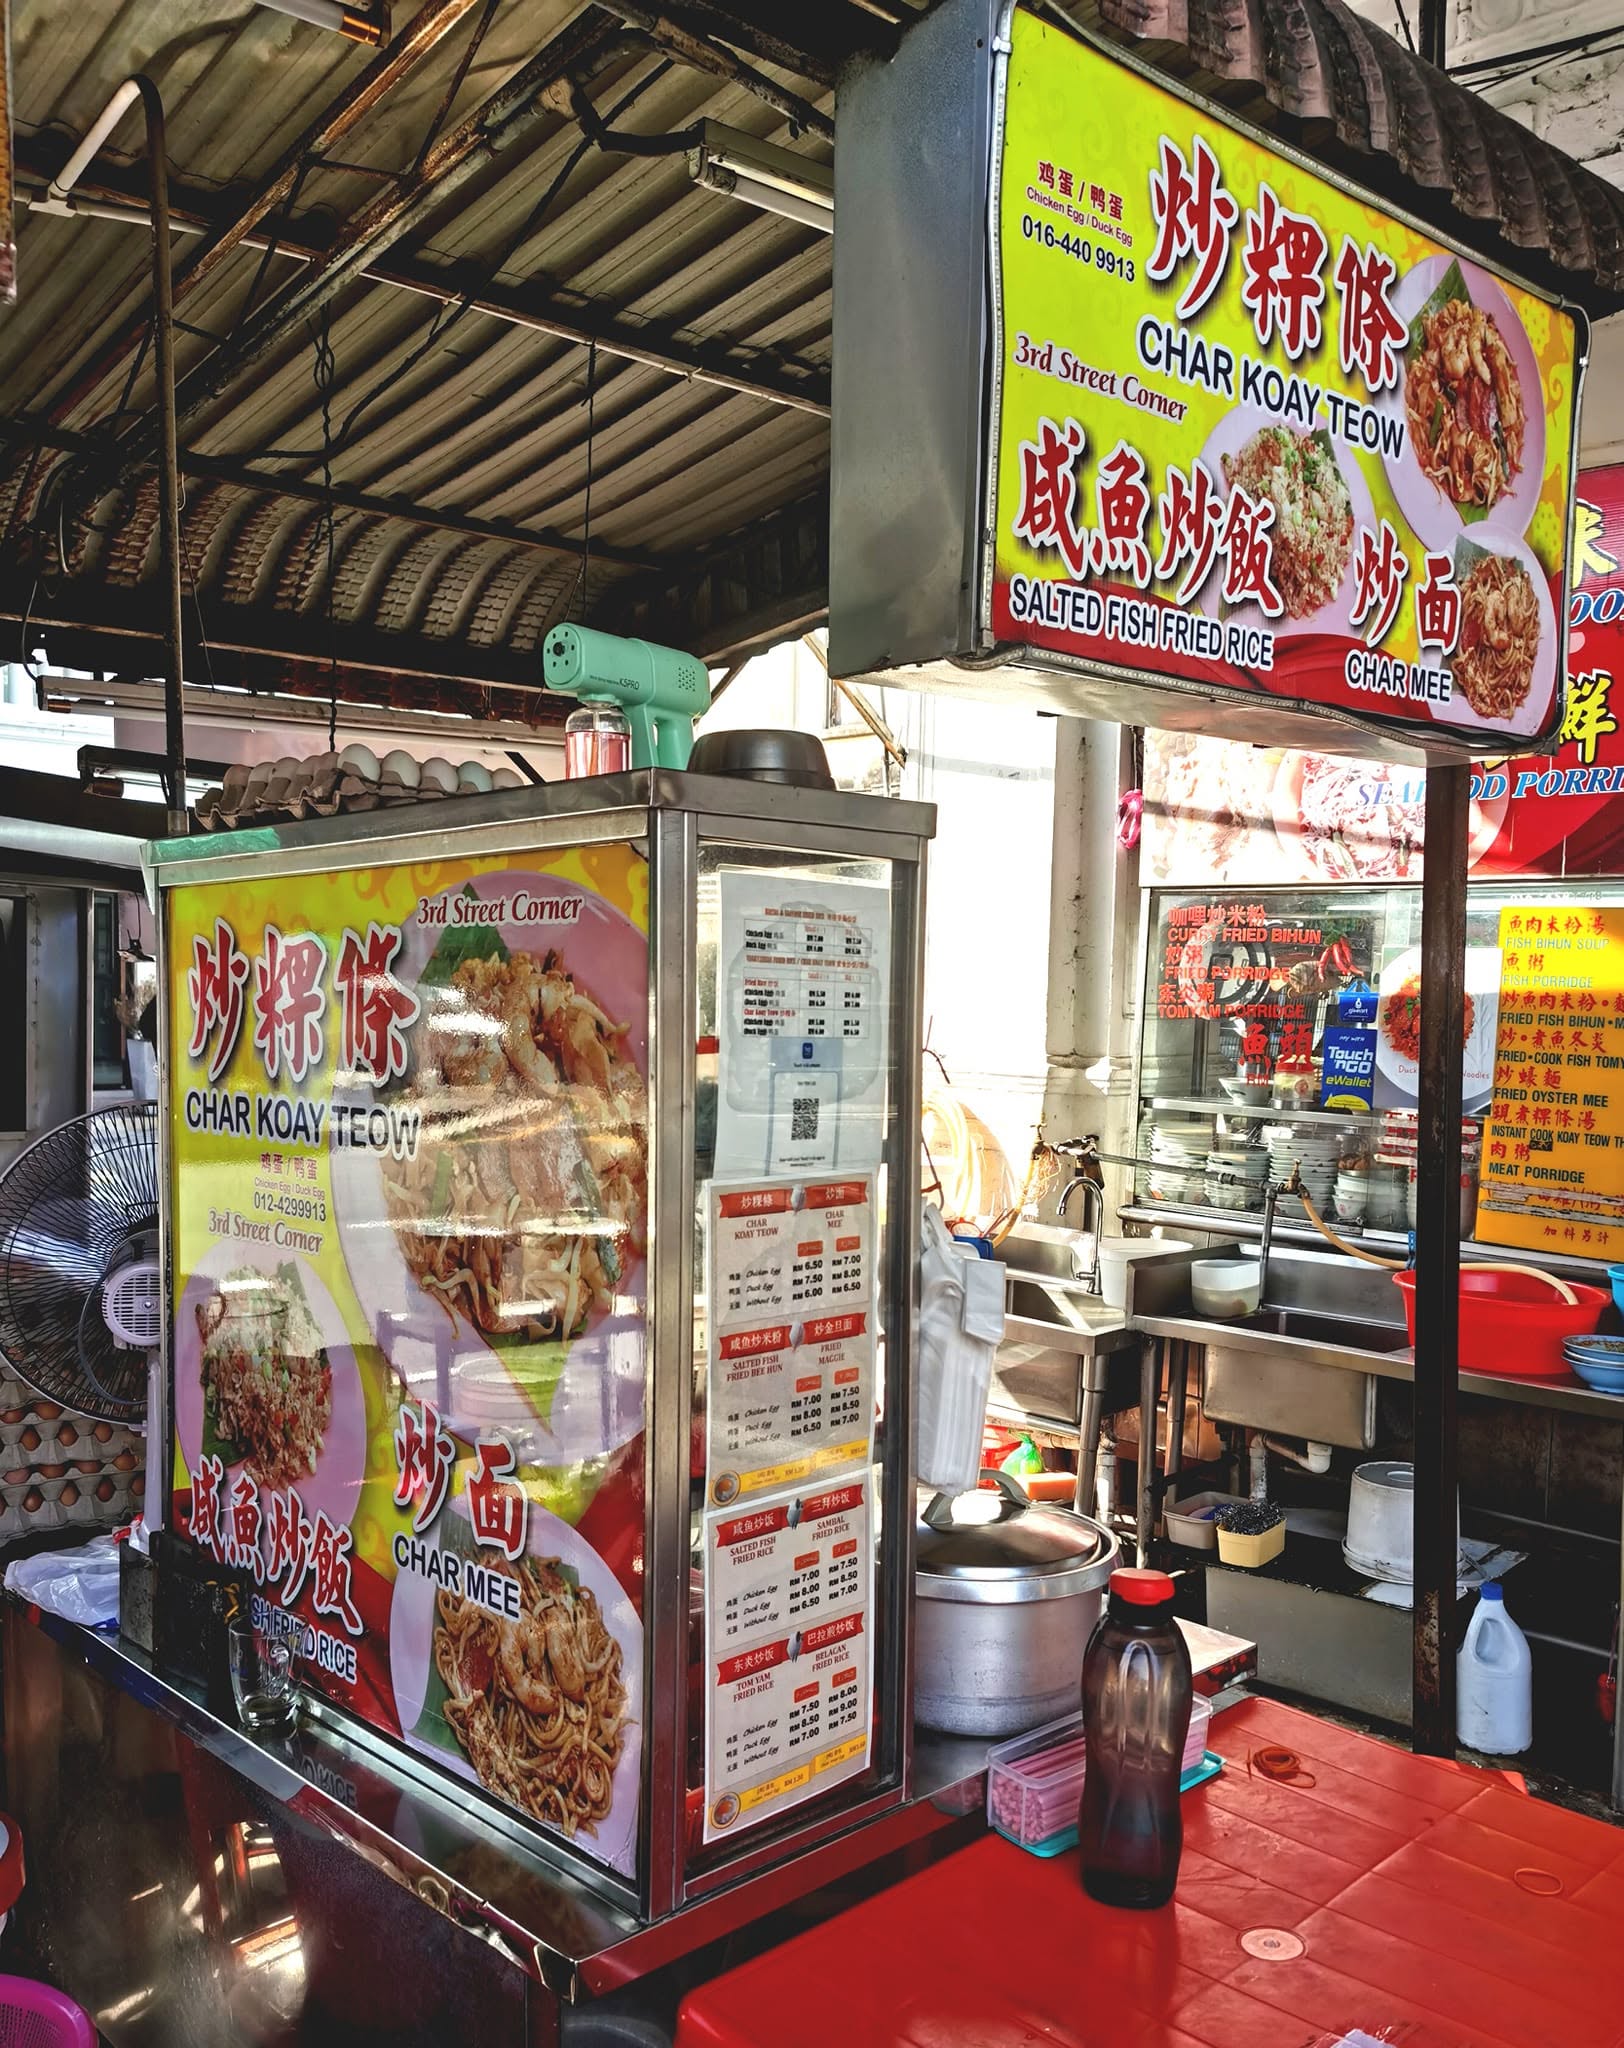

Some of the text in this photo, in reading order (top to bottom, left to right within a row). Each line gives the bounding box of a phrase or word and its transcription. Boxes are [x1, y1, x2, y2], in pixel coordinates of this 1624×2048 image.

[1039, 161, 1123, 221] 鸡蛋 鸭蛋
[1027, 186, 1133, 248] Chicken Egg Duck Egg
[1022, 215, 1135, 282] 016-440 9913
[1015, 335, 1188, 421] 3rd Street Corner
[1140, 321, 1405, 459] CHAR KOAY TEOW
[1012, 578, 1273, 667] SALTED FISH FRIED RICE
[1348, 653, 1452, 701] CHAR MEE
[418, 893, 582, 924] 3rd Street Corner
[1222, 928, 1268, 943] FRIED
[1271, 927, 1321, 944] BIHUN
[1505, 937, 1609, 950] FISH BIHUN SOUP
[1165, 966, 1291, 982] FRIED PORRIDGE
[1503, 974, 1593, 988] FISH PORRIDGE
[1224, 1005, 1305, 1019] PORRIDGE
[1500, 1012, 1533, 1025] FRIED
[1538, 1014, 1565, 1026] FISH
[1328, 1046, 1374, 1062] Touch
[1567, 1053, 1591, 1067] FISH
[1398, 1064, 1417, 1074] Duck
[1325, 1075, 1372, 1088] eWallet
[1494, 1087, 1608, 1108] FRIED OYSTER MEE
[187, 1090, 419, 1157] CHAR KOAY TEOW
[1491, 1125, 1611, 1148] INSTANT COOK KOAY TEOW
[1488, 1162, 1585, 1184] MEAT PORRIDGE
[254, 1176, 279, 1190] Chicken
[295, 1183, 313, 1195] Duck
[254, 1191, 326, 1222] 012-4299913
[825, 1210, 844, 1220] CHAR
[208, 1211, 323, 1253] 3rd Street Corner
[746, 1218, 767, 1229] CHAR
[827, 1219, 842, 1229] MEE
[734, 1226, 779, 1240] KOAY TEOW
[792, 1259, 823, 1272] RM 6.50
[832, 1254, 861, 1267] RM 7.00
[792, 1273, 823, 1286] RM 7.50
[832, 1268, 861, 1280] RM 8.00
[820, 1342, 841, 1353] FRIED
[732, 1354, 779, 1371] SALTED FISH
[818, 1353, 845, 1365] MAGGIE
[727, 1364, 783, 1382] FRIED BEE HUN
[811, 1522, 850, 1541] FRIED RICE
[817, 1515, 845, 1531] SAMBAL
[730, 1536, 776, 1557] SALTED FISH
[732, 1545, 774, 1566] FRIED RICE
[828, 1557, 858, 1574] RM 7.50
[395, 1535, 519, 1619] CHAR MEE
[789, 1569, 820, 1587] RM 7.00
[828, 1570, 858, 1587] RM 8.50
[789, 1583, 820, 1600] RM 8.00
[828, 1583, 858, 1600] RM 7.00
[789, 1596, 820, 1614] RM 6.50
[318, 1631, 357, 1681] RICE
[811, 1651, 850, 1672] FRIED RICE
[815, 1645, 847, 1661] BELACAN
[737, 1672, 771, 1692] TOM YAM
[733, 1680, 774, 1703] FRIED RICE
